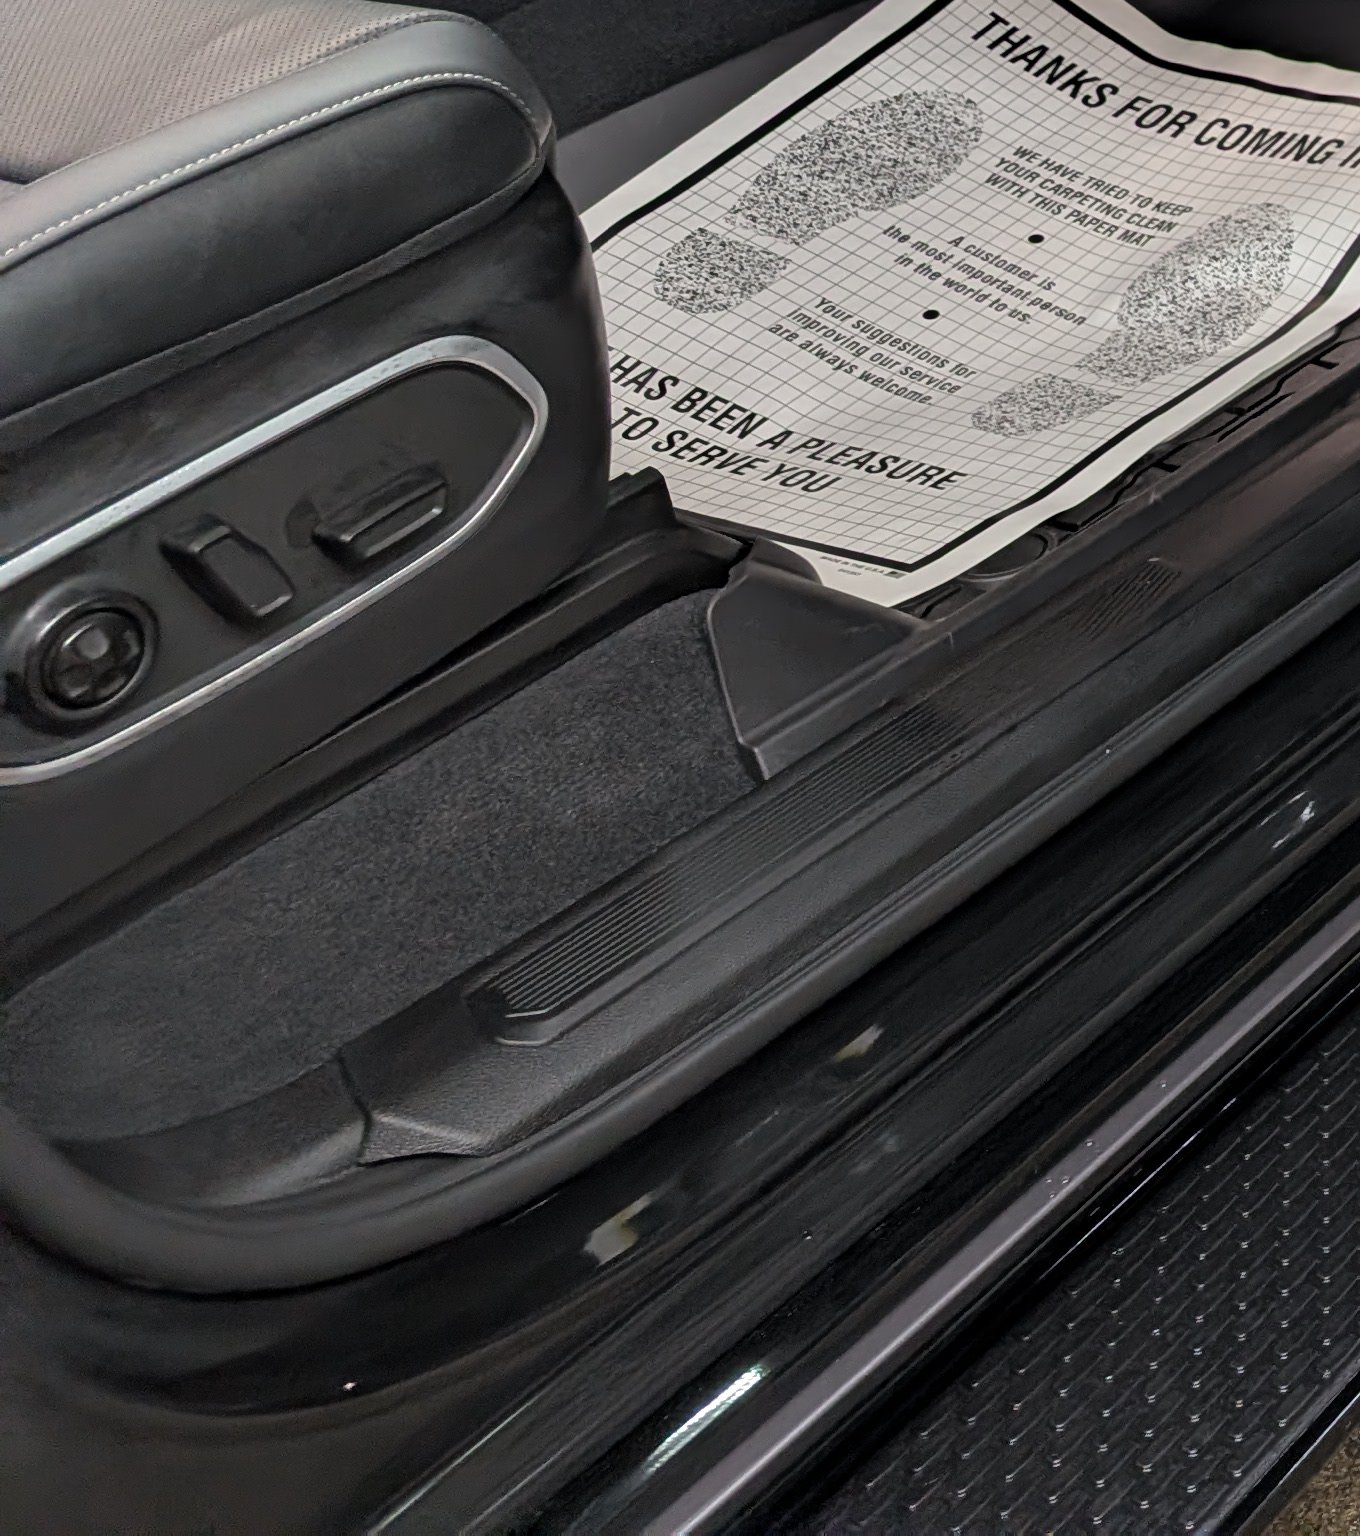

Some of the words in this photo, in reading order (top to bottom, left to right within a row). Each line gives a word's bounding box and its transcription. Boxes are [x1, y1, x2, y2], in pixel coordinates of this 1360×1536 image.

[971, 12, 1119, 110] THANKS
[1112, 95, 1198, 139] FOR
[1194, 118, 1345, 167] COMING
[984, 172, 1030, 199] WITH
[1028, 192, 1067, 215] THIS
[1065, 209, 1119, 238] PAPER
[1117, 229, 1155, 248] MAT
[994, 157, 1041, 183] YOUR
[1039, 178, 1127, 221] CARPETING
[1126, 212, 1178, 233] CLEAN
[1013, 145, 1041, 164] WE
[1043, 158, 1084, 183] HAVE
[1082, 175, 1130, 200] TRIED
[1131, 194, 1153, 209] TO
[1153, 201, 1193, 217] KEEP
[882, 224, 911, 243] the
[911, 240, 954, 265] most
[951, 258, 1032, 301] important
[1028, 295, 1087, 326] person
[894, 252, 914, 267] in
[913, 262, 942, 281] the
[942, 277, 990, 304] world
[989, 298, 1008, 313] to
[1010, 308, 1031, 325] us.
[948, 236, 965, 248] A
[963, 244, 1039, 283] customer
[1037, 276, 1056, 291] is
[768, 322, 800, 343] are
[799, 339, 859, 375] always
[858, 368, 933, 406] welcome.
[786, 308, 870, 358] improving
[869, 352, 901, 370] our
[899, 364, 962, 394] service
[814, 297, 854, 323] Your
[852, 318, 950, 370] suggestions
[948, 363, 977, 379] for
[610, 354, 680, 400] HAS
[670, 386, 769, 440] BEEN
[756, 431, 794, 451] A
[787, 437, 969, 491] PLEASURE
[611, 406, 659, 441] TO
[652, 429, 769, 477] SERVE
[761, 463, 842, 493] YOU
